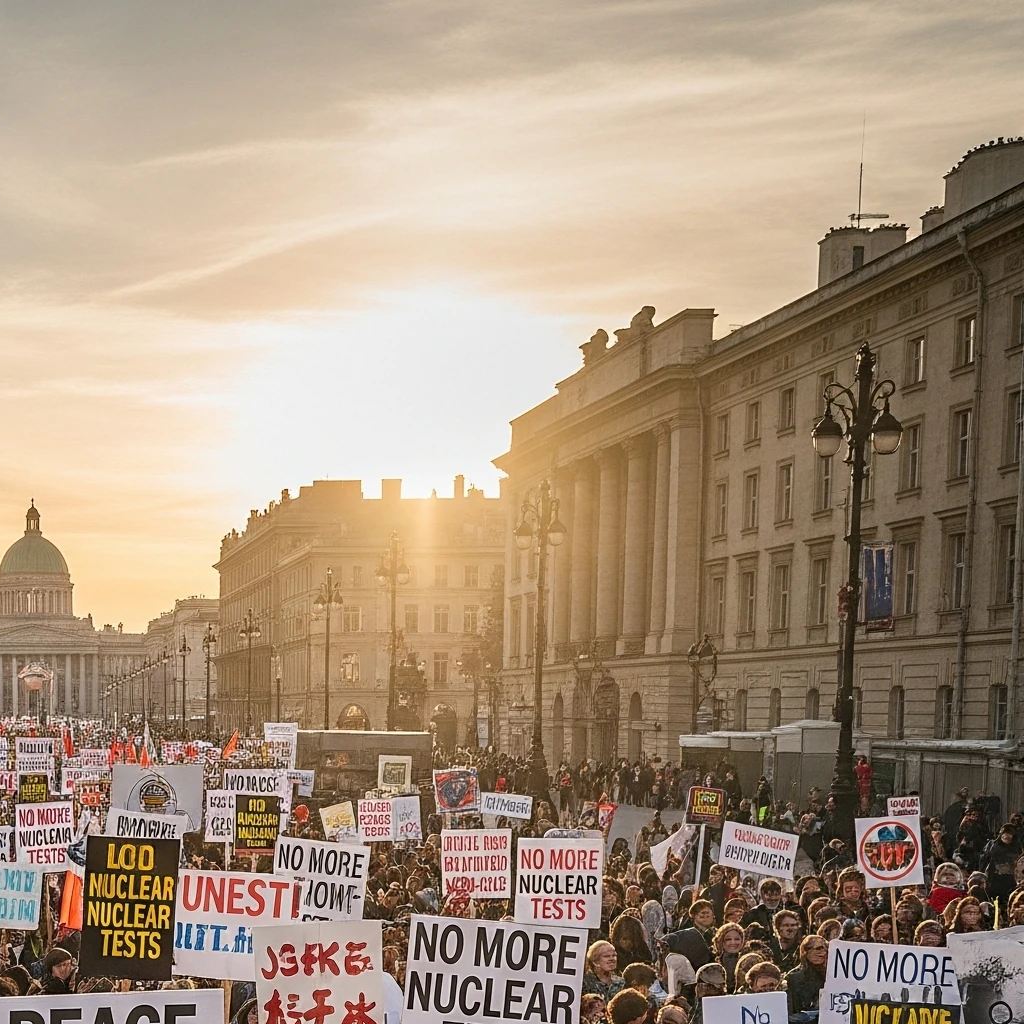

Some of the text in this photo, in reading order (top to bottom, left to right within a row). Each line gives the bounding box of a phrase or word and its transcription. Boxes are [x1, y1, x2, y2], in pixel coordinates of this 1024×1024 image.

[278, 844, 365, 878] NO MORE
[521, 849, 544, 870] NO
[549, 849, 599, 870] MORE
[519, 875, 597, 895] NUCLEAR
[87, 901, 171, 930] NUCLEAR
[531, 898, 586, 920] TESTS
[101, 929, 161, 960] TESTS
[413, 922, 580, 976] NO MORE
[834, 948, 955, 987] NO MORE
[407, 971, 575, 1024] NUCLEAR
